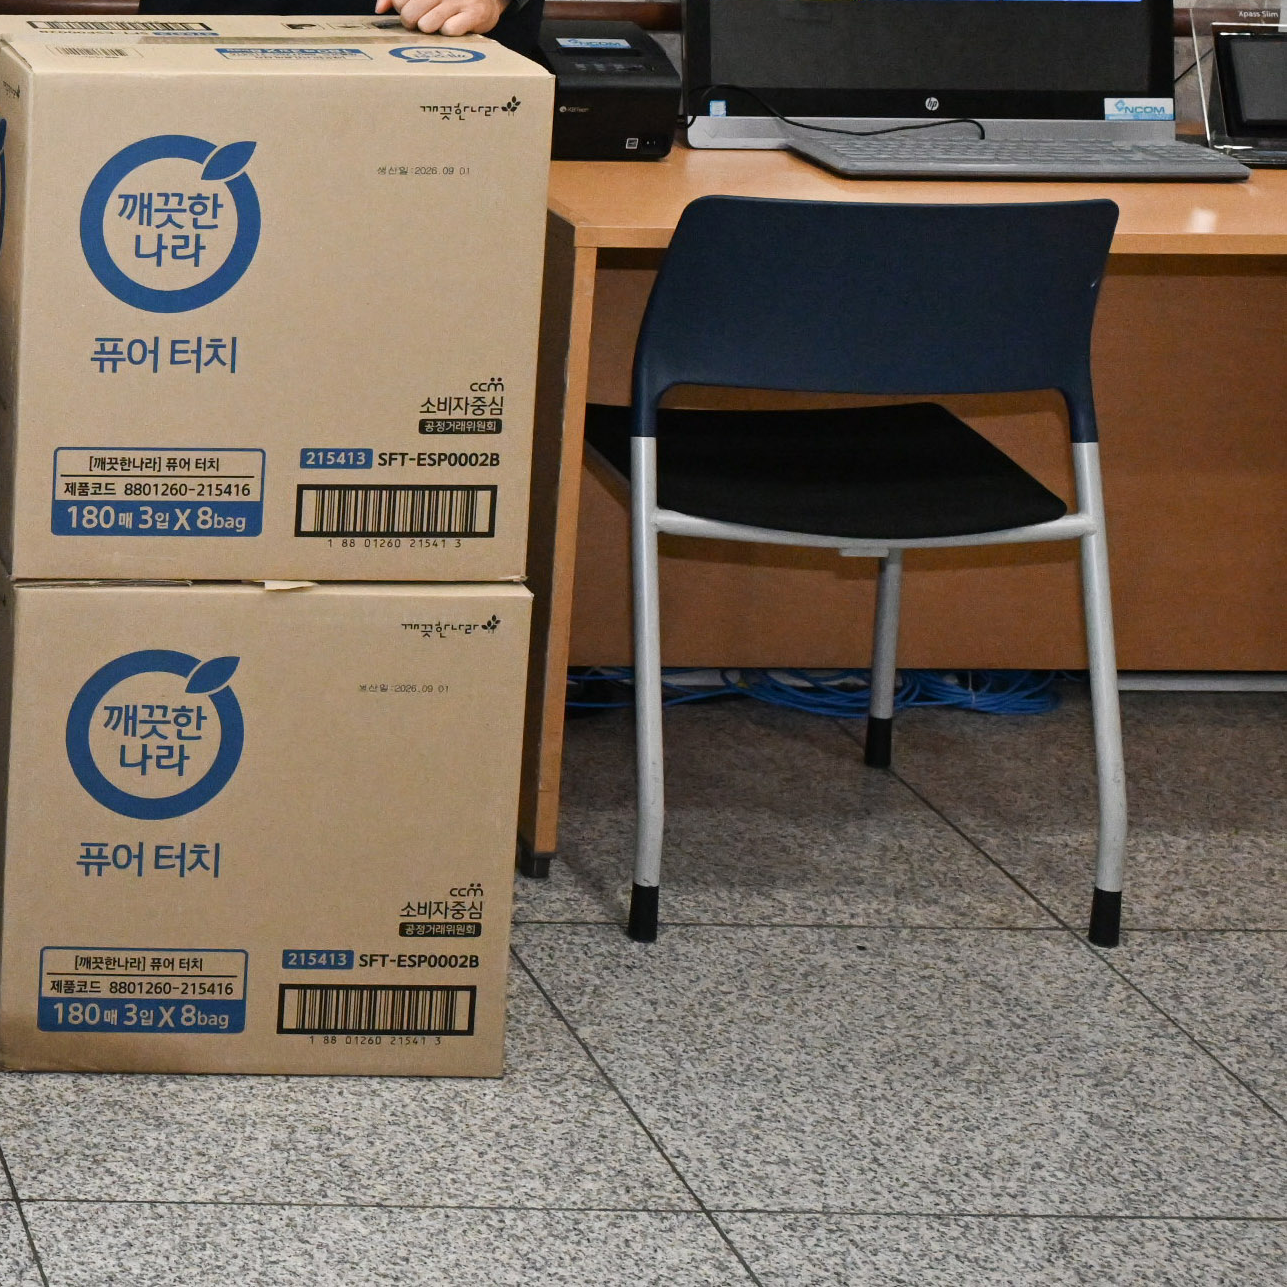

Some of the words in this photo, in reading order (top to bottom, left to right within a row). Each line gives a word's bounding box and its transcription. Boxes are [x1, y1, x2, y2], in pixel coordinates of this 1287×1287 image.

[118, 191, 224, 230] 깨끗한
[134, 233, 206, 268] 나라
[90, 337, 161, 375] 퓨어
[169, 336, 238, 374] 터치
[419, 395, 504, 416] 소비자중심
[424, 420, 497, 433] 공정거래위원회
[305, 450, 367, 467] 215413
[377, 451, 501, 468] SFT-ESP0002B
[103, 704, 208, 742] 깨끗한
[119, 744, 190, 777] 나라
[76, 842, 145, 878] 퓨어
[153, 843, 221, 879] 터치
[399, 899, 484, 921] 소비자중심
[404, 923, 476, 936] 공정거래위원회
[287, 952, 348, 967] 215413
[358, 953, 480, 969] SFT-ESP0002B
